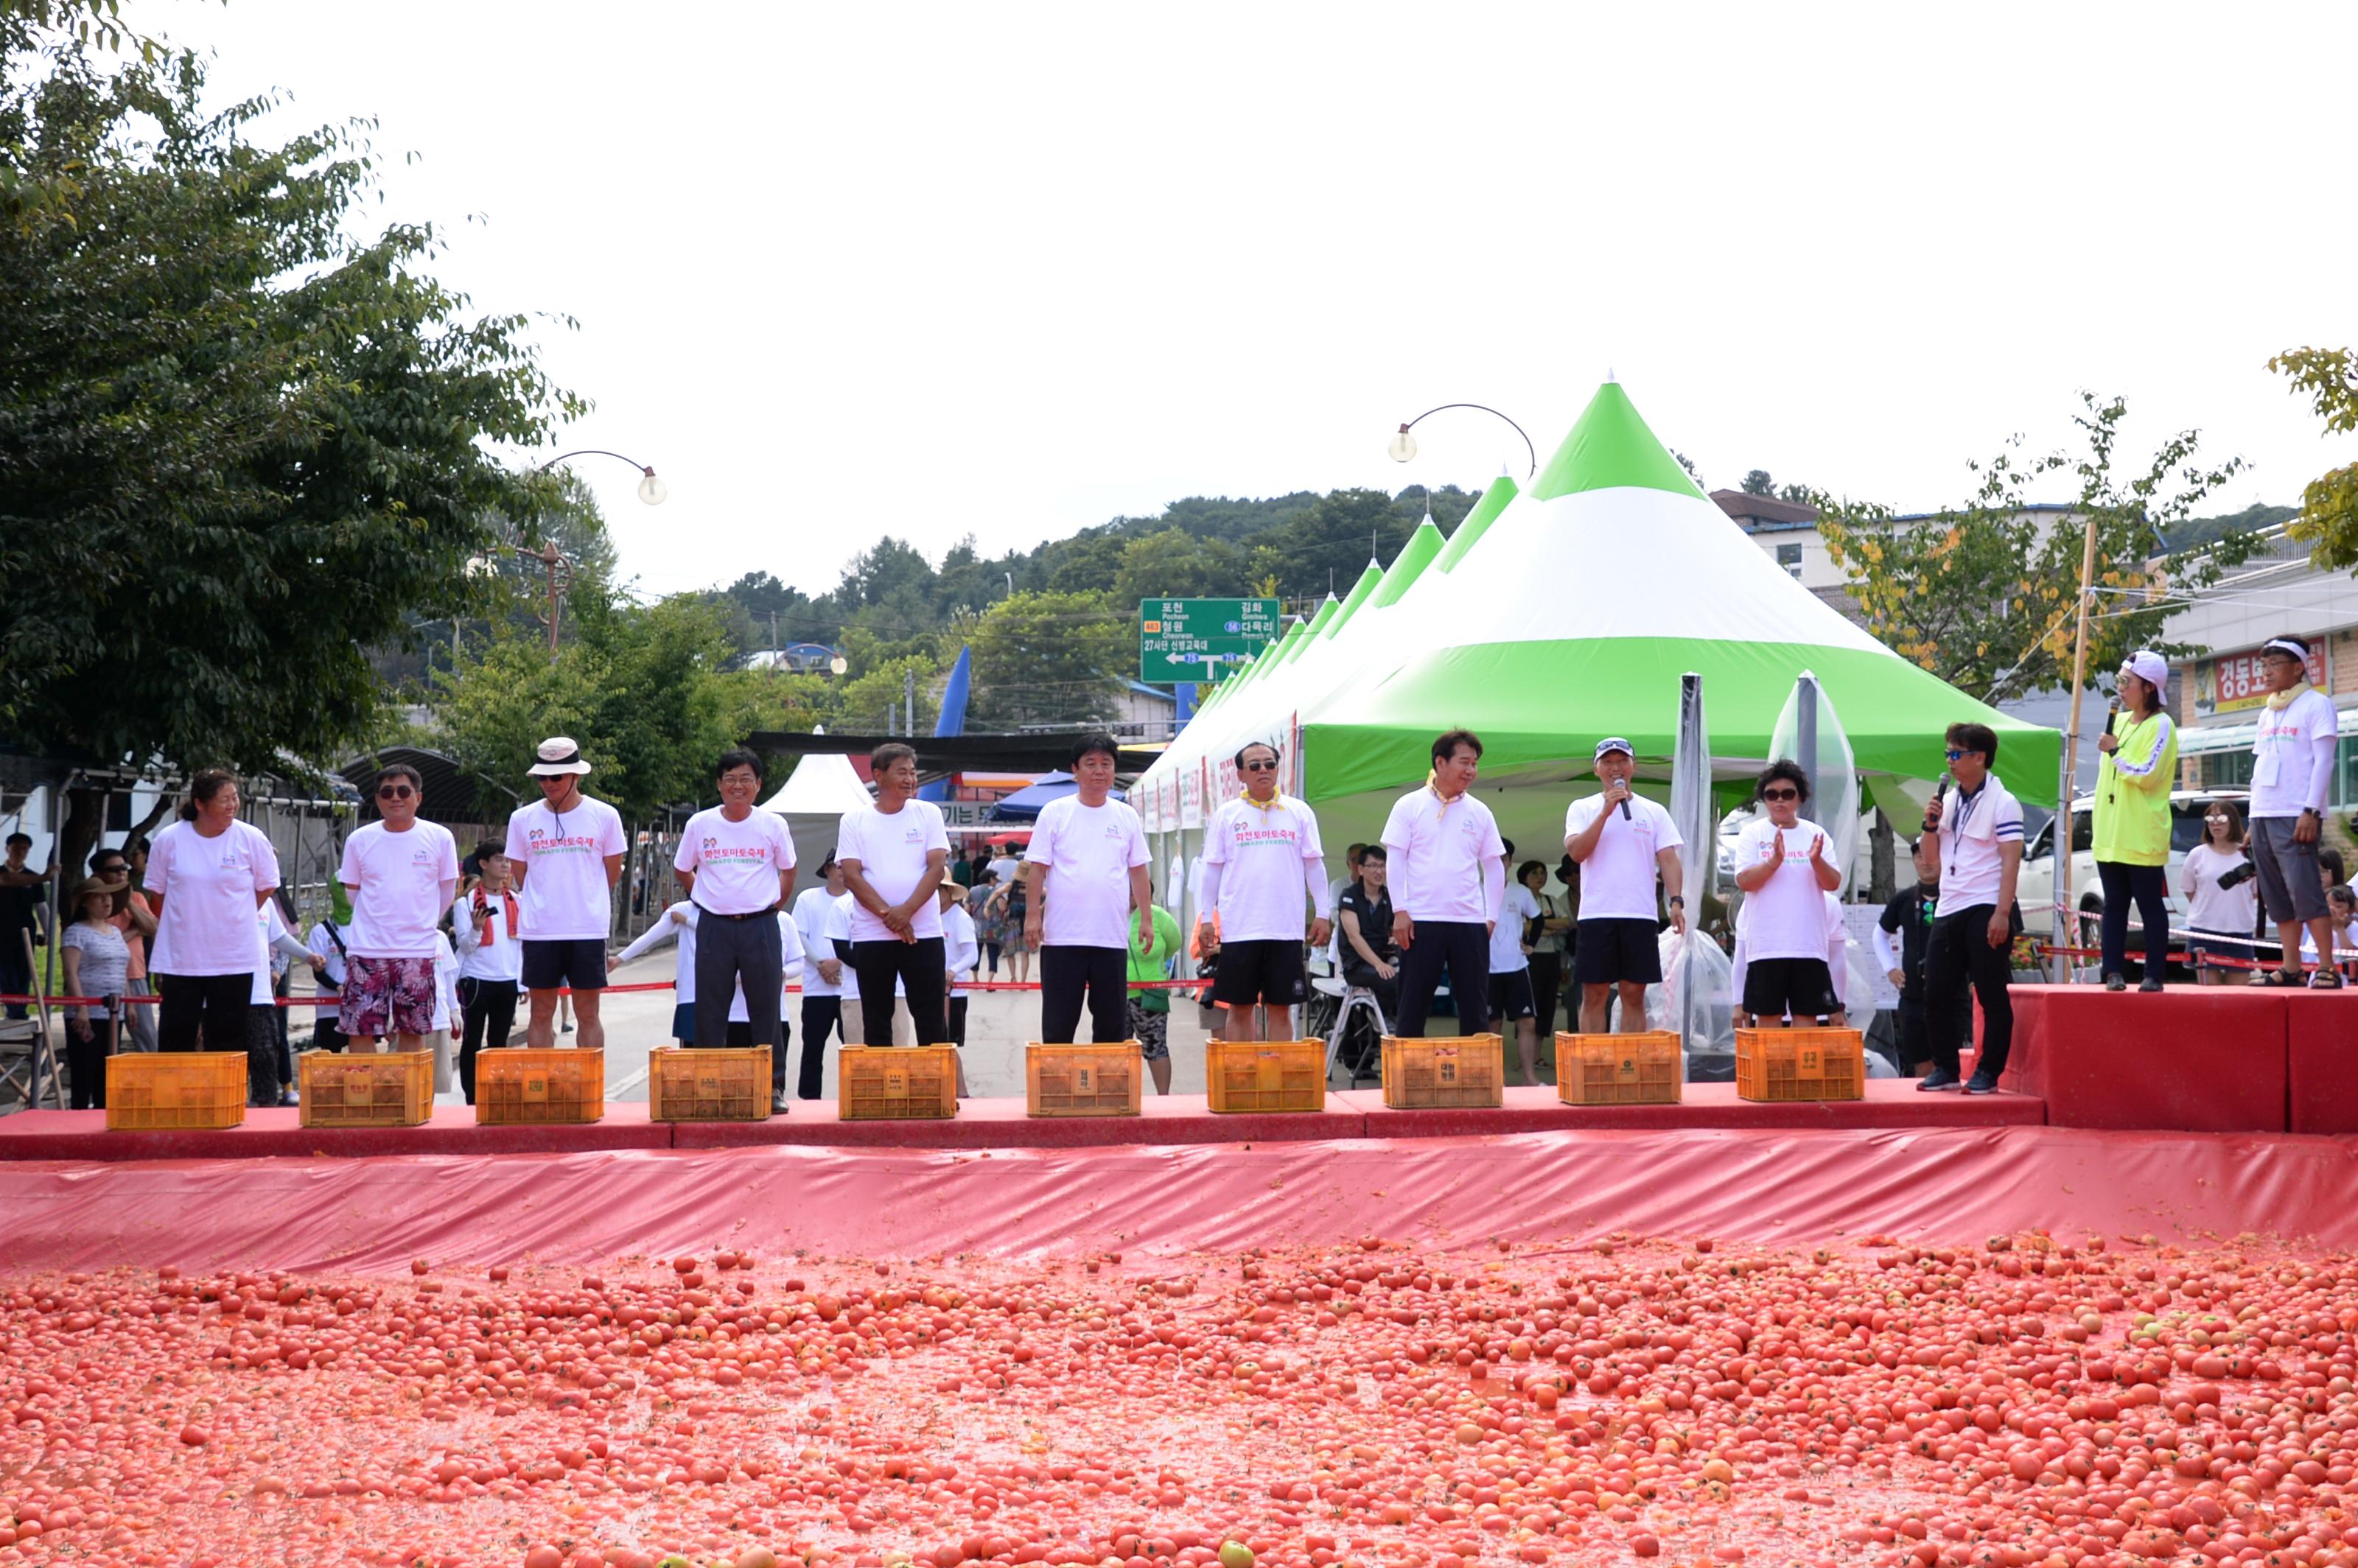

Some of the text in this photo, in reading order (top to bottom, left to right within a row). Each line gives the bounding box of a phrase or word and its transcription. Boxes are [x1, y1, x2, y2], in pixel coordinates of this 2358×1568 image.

[1162, 601, 1183, 613] 포천
[1241, 601, 1262, 613] 김화
[1162, 620, 1183, 632] 철원
[1241, 620, 1273, 632] 다목리
[1144, 640, 1208, 651] 27사단 신병교육대
[1187, 654, 1196, 662] 75
[1235, 829, 1295, 841] 화천토마토축제
[531, 836, 595, 850] 화천토마토축제
[704, 848, 766, 859] 화천토마토축제
